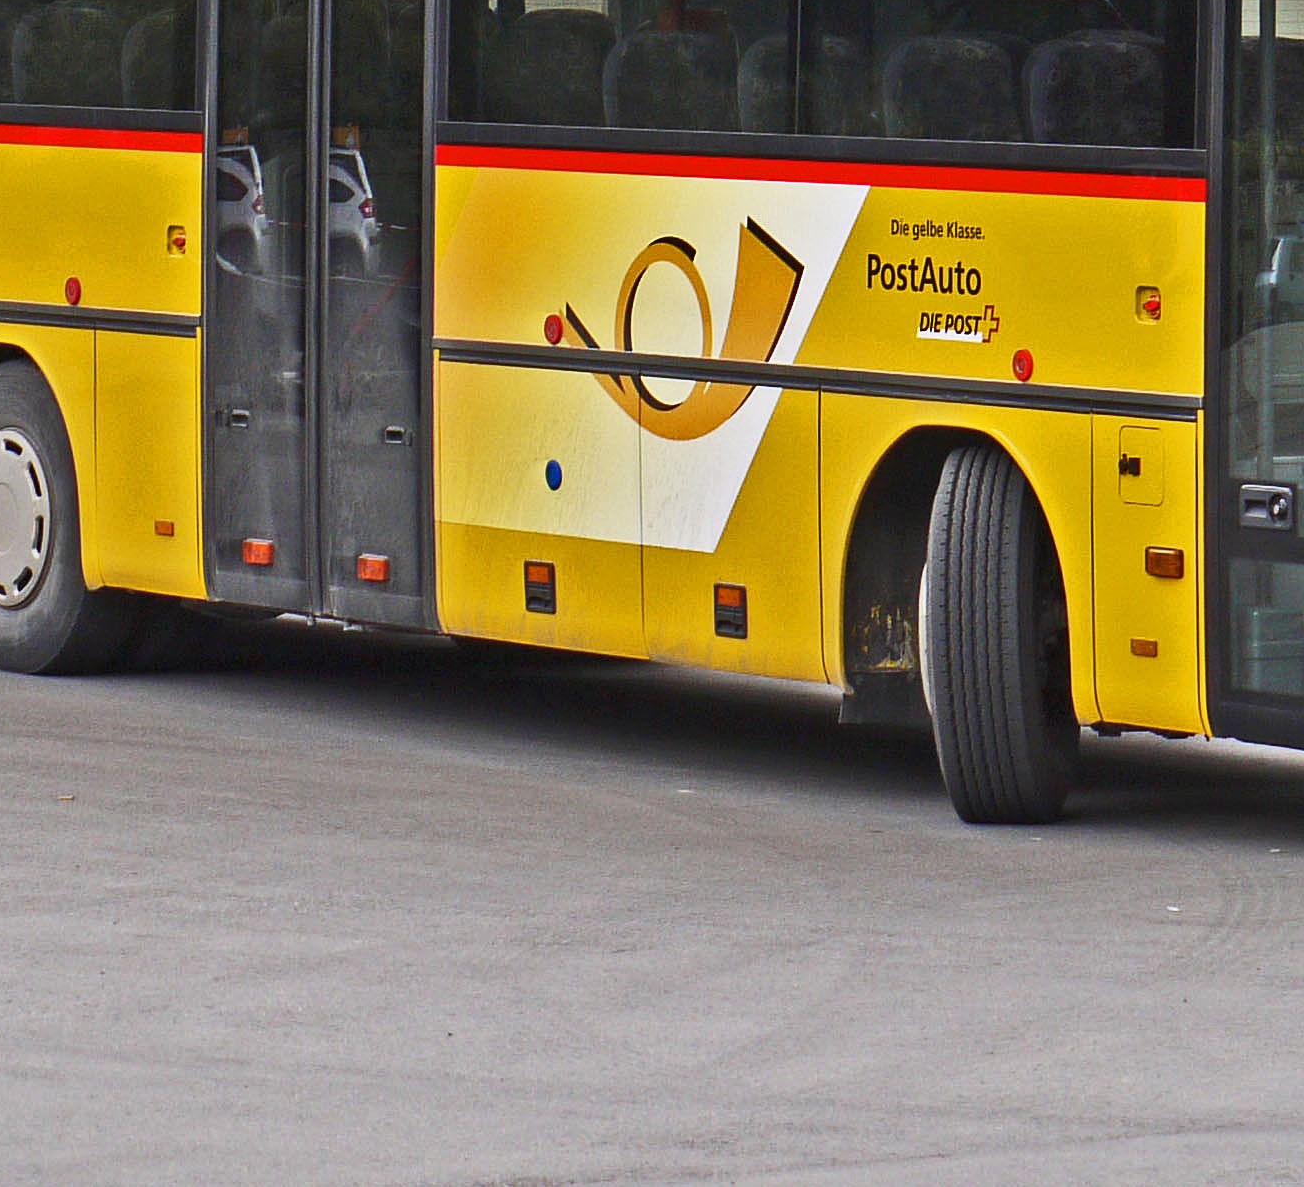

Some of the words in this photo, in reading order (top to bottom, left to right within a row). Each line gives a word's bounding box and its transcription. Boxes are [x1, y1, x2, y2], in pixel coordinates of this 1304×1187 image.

[890, 218, 910, 236] Die
[912, 219, 944, 241] gelbe
[946, 221, 986, 240] Klasse.
[866, 253, 982, 296] PostAuto
[919, 312, 943, 333] DIE
[944, 314, 982, 335] POST
